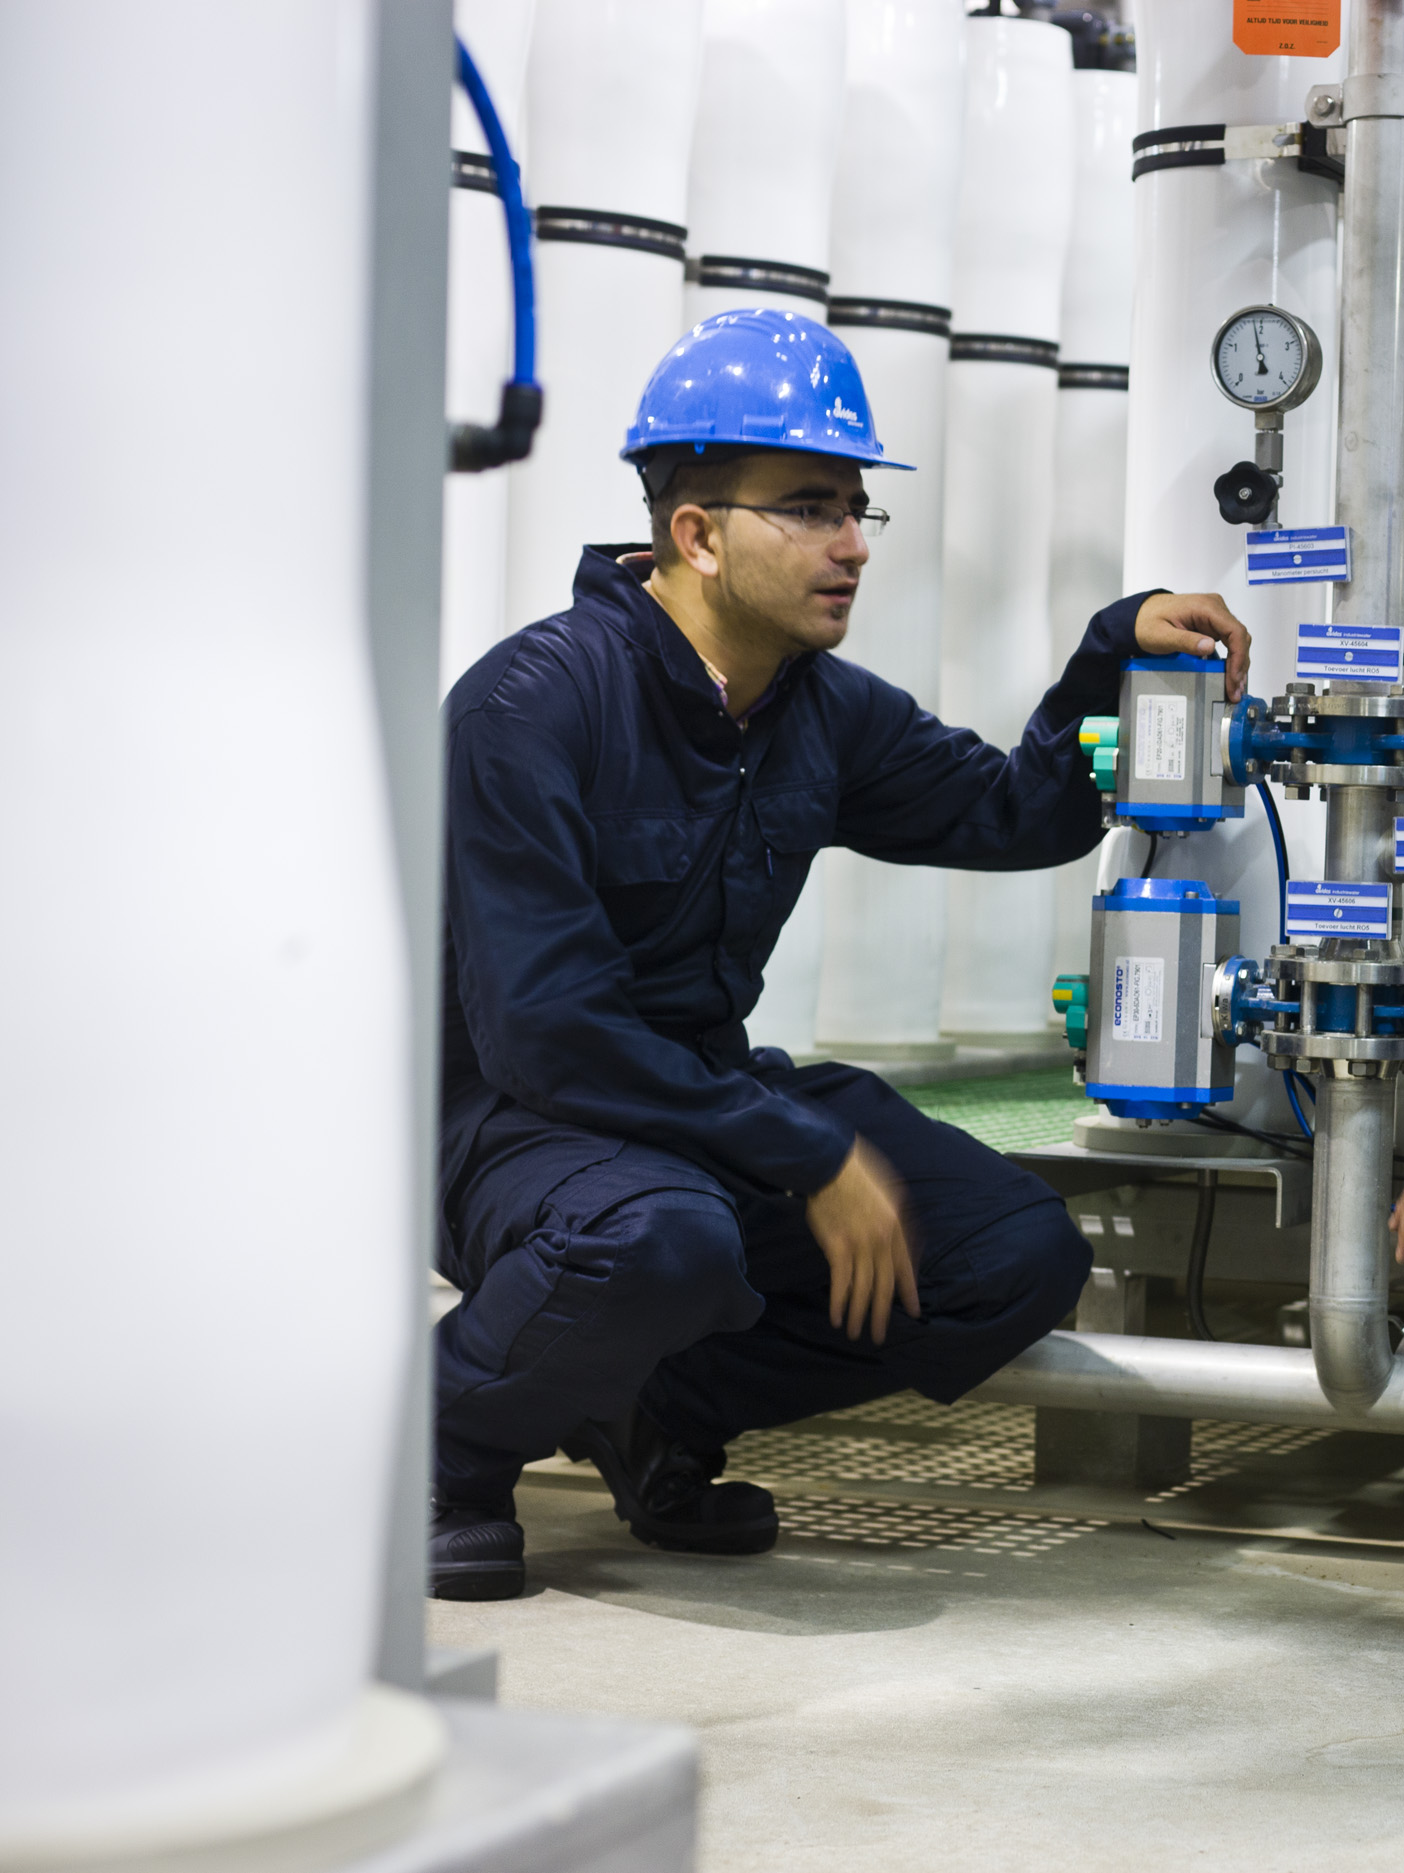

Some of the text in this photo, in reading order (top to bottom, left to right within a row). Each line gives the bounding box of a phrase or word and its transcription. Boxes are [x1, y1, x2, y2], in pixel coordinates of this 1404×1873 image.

[1259, 325, 1264, 334] 2
[1233, 343, 1238, 352] 1
[1285, 342, 1289, 351] 3
[1238, 372, 1243, 382] 0
[1279, 371, 1284, 380] 4
[1271, 567, 1329, 577] Manometer perslucht
[1324, 665, 1349, 673] Toevoer
[1314, 922, 1339, 930] Toevoer
[1221, 998, 1229, 1021] Kiwa
